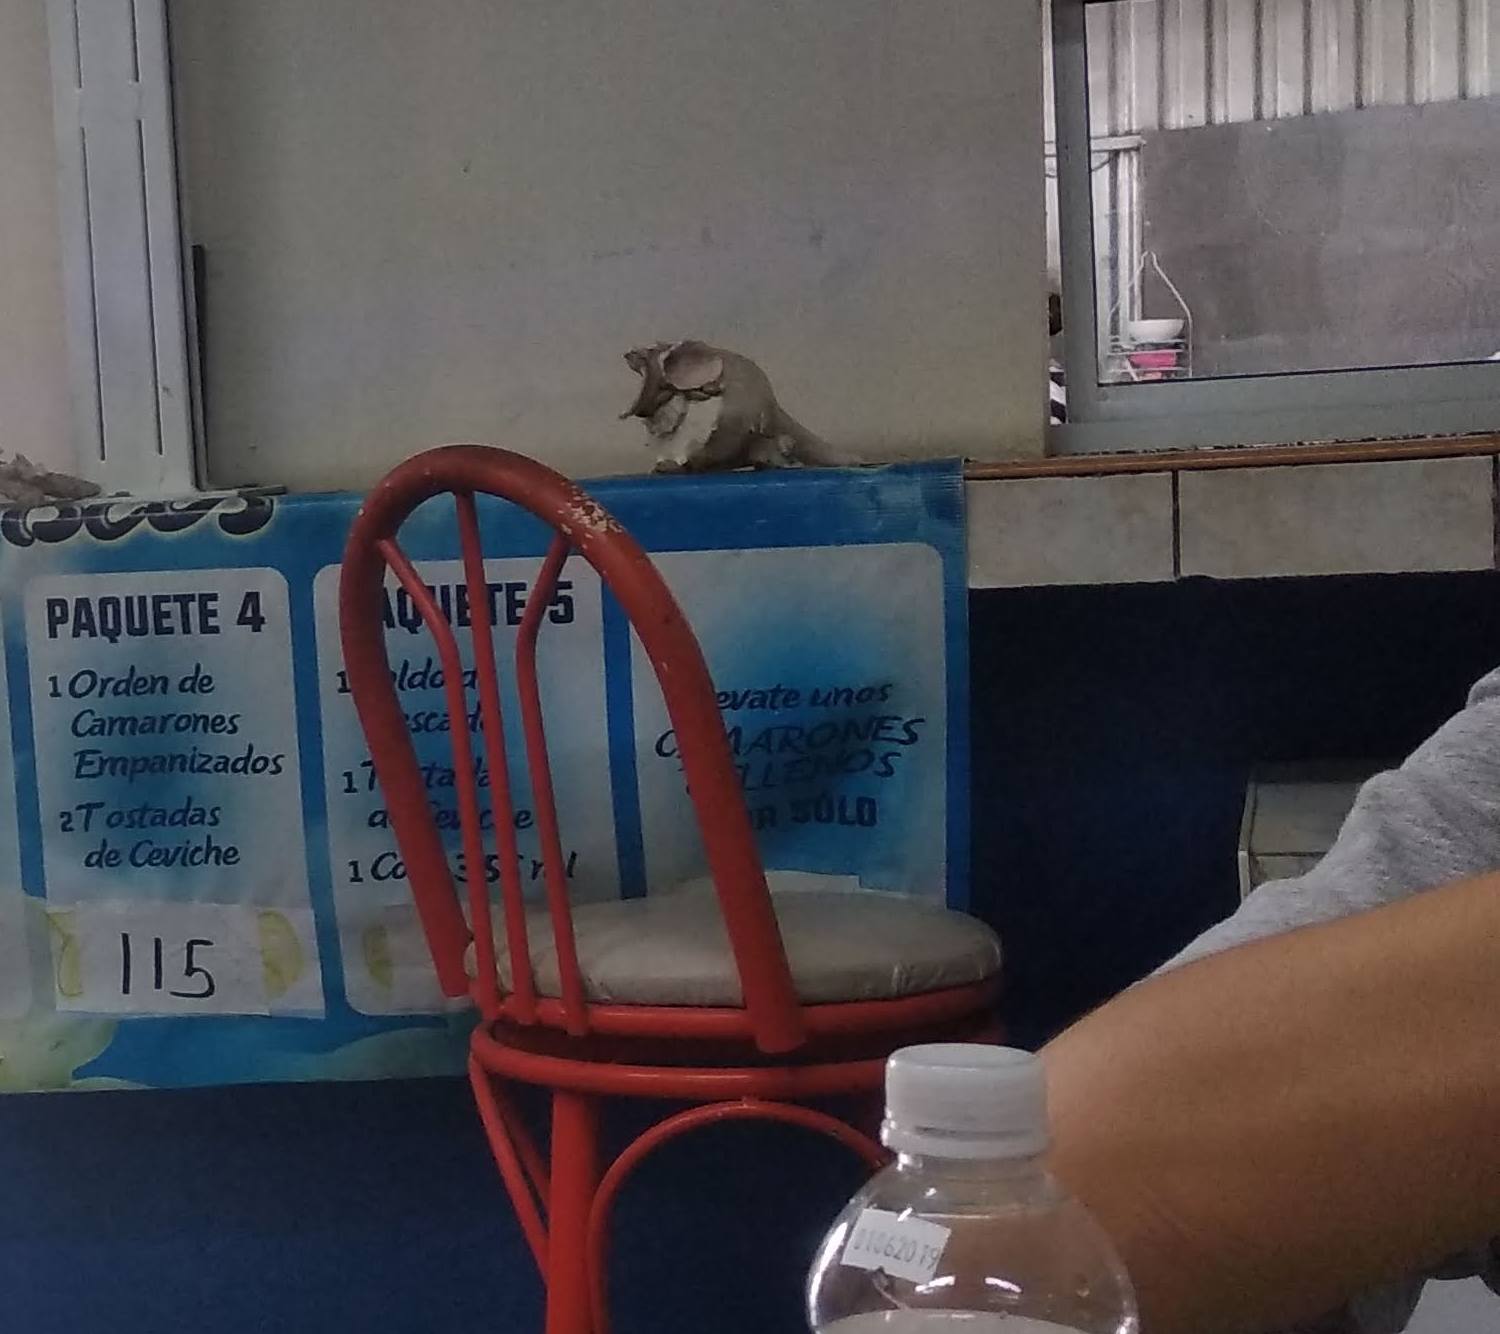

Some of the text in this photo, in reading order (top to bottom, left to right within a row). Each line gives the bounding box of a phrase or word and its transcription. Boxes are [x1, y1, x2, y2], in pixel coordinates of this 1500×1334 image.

[46, 591, 266, 644] PAQUETE 4
[548, 581, 575, 625] 5
[49, 664, 216, 699] 1 Orden de
[336, 669, 352, 694] 1
[713, 682, 893, 711] evate unos
[71, 709, 240, 738] Camarones
[654, 715, 926, 759] CMARONES
[73, 747, 285, 781] Empanizados
[342, 770, 359, 795] 1
[60, 796, 221, 833] 2 Tostadas
[84, 839, 241, 869] de Ceviche
[347, 859, 364, 883] 1
[120, 932, 217, 999] 115
